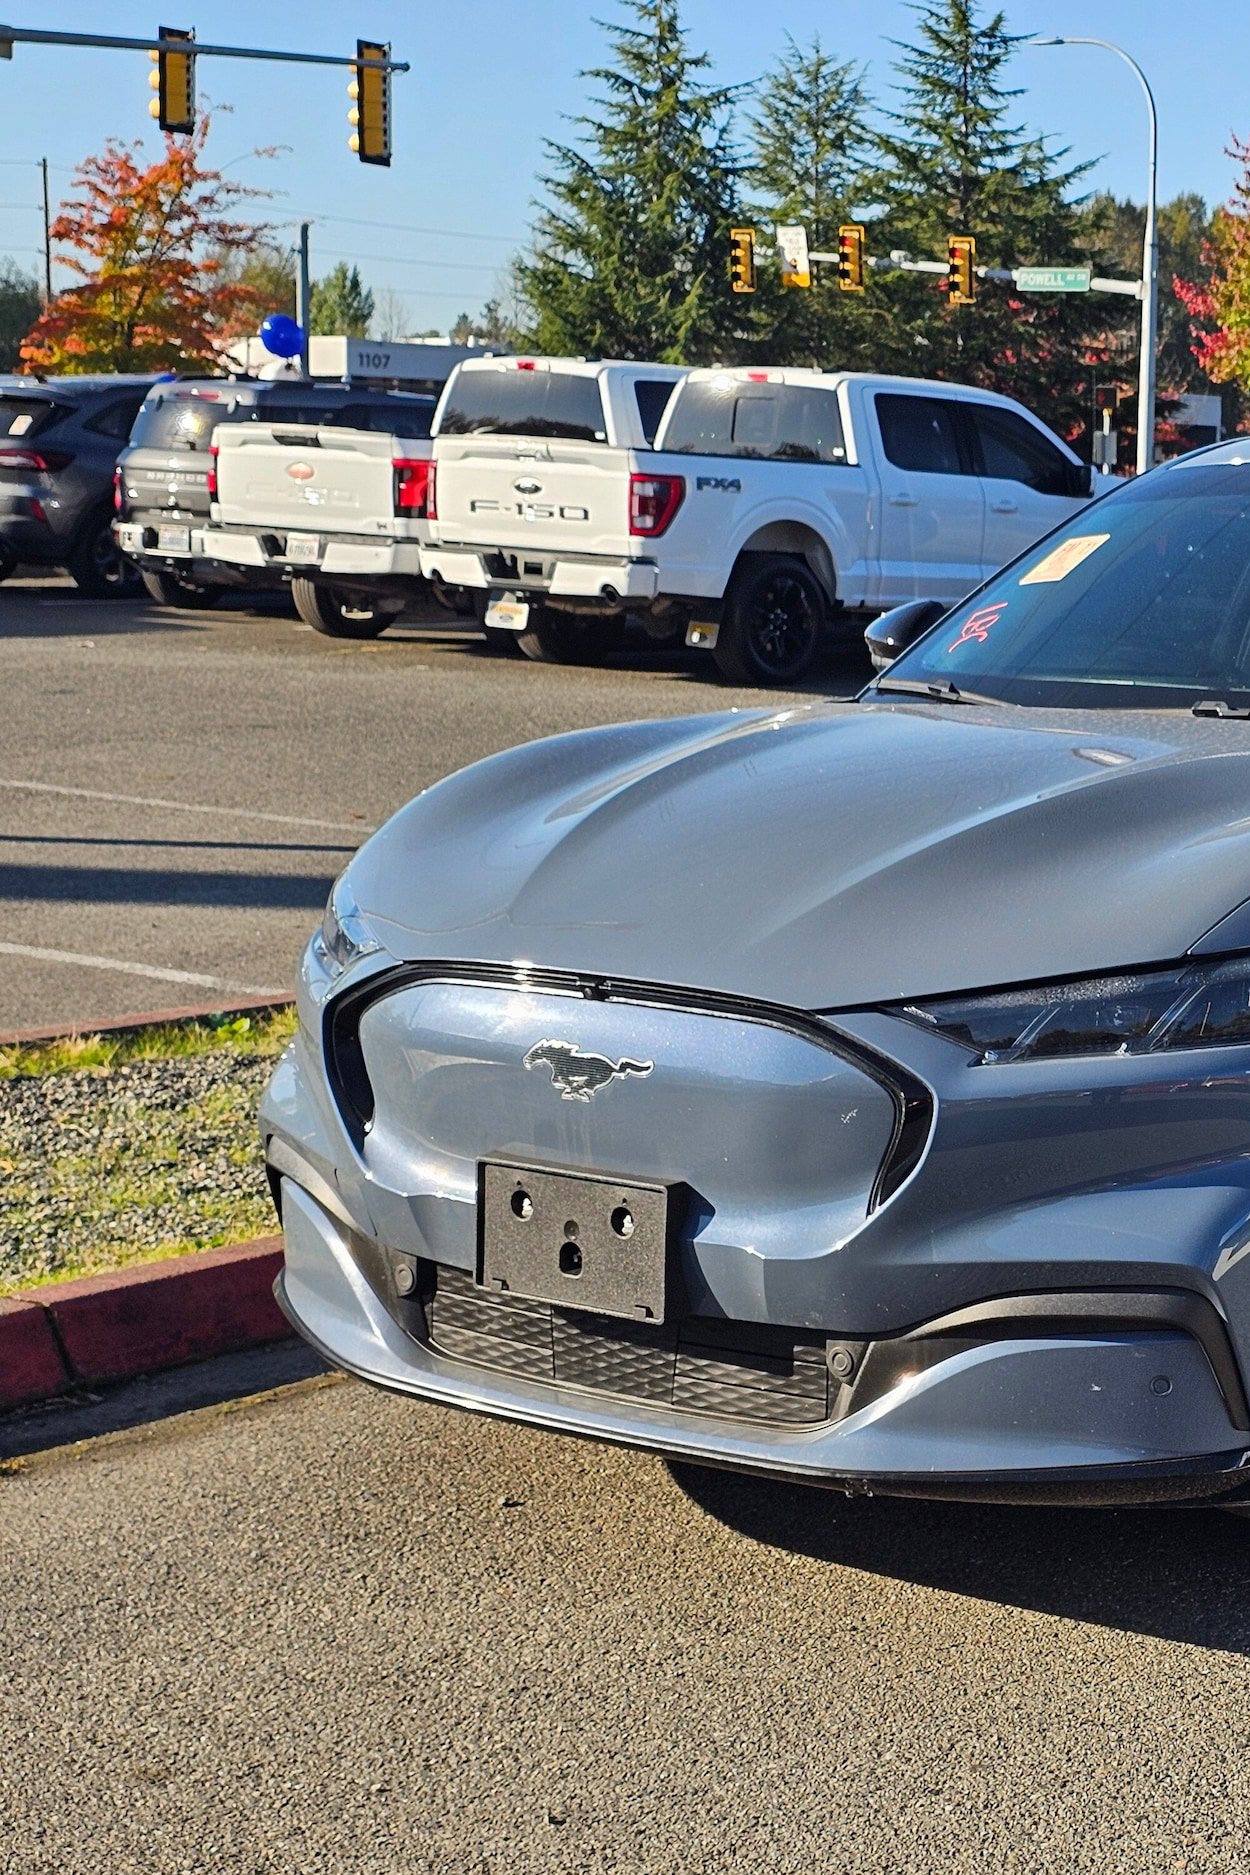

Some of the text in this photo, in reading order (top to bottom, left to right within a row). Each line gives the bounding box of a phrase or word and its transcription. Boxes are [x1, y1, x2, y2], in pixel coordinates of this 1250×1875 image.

[1020, 272, 1066, 286] POWELL
[358, 352, 391, 369] 1107
[696, 476, 741, 493] FX4
[470, 500, 589, 521] F-150
